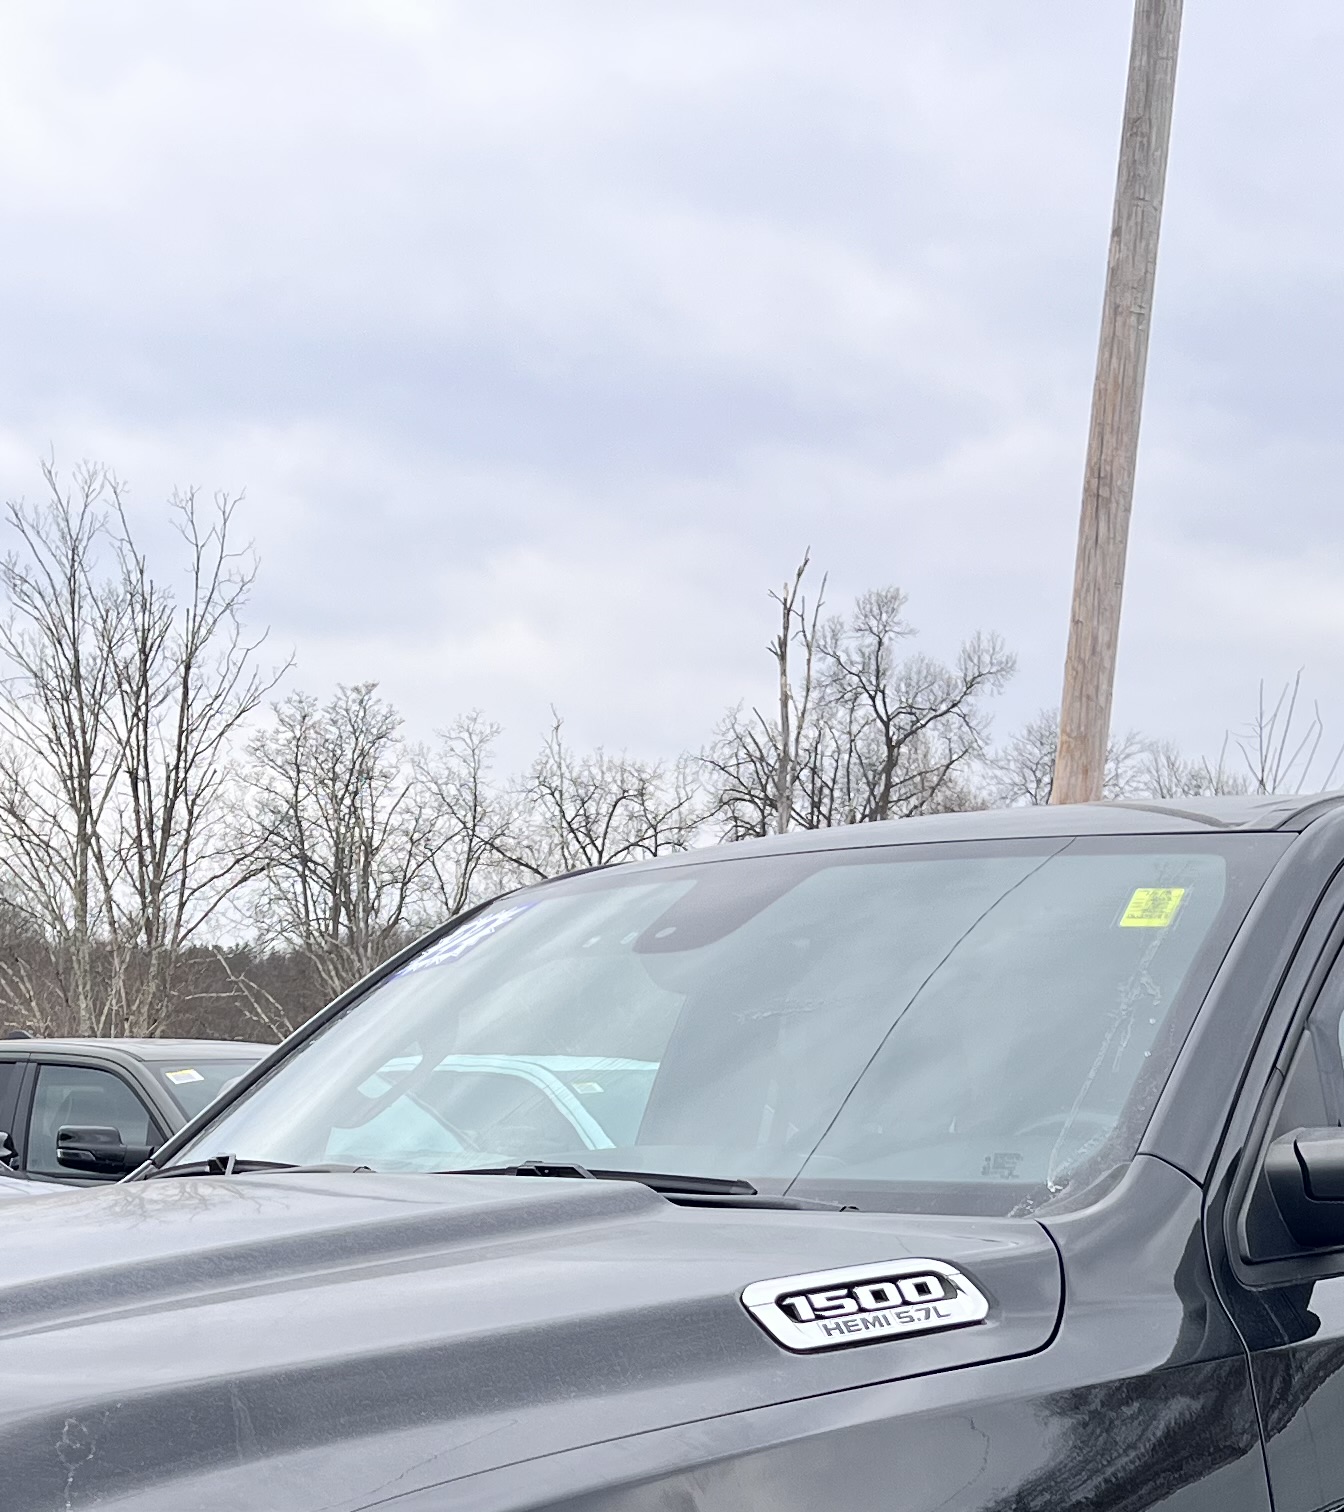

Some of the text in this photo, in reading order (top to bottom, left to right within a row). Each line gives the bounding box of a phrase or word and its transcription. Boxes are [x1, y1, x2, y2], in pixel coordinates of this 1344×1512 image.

[781, 1275, 946, 1322] 1500
[822, 1306, 952, 1337] HEMI 5.7L
